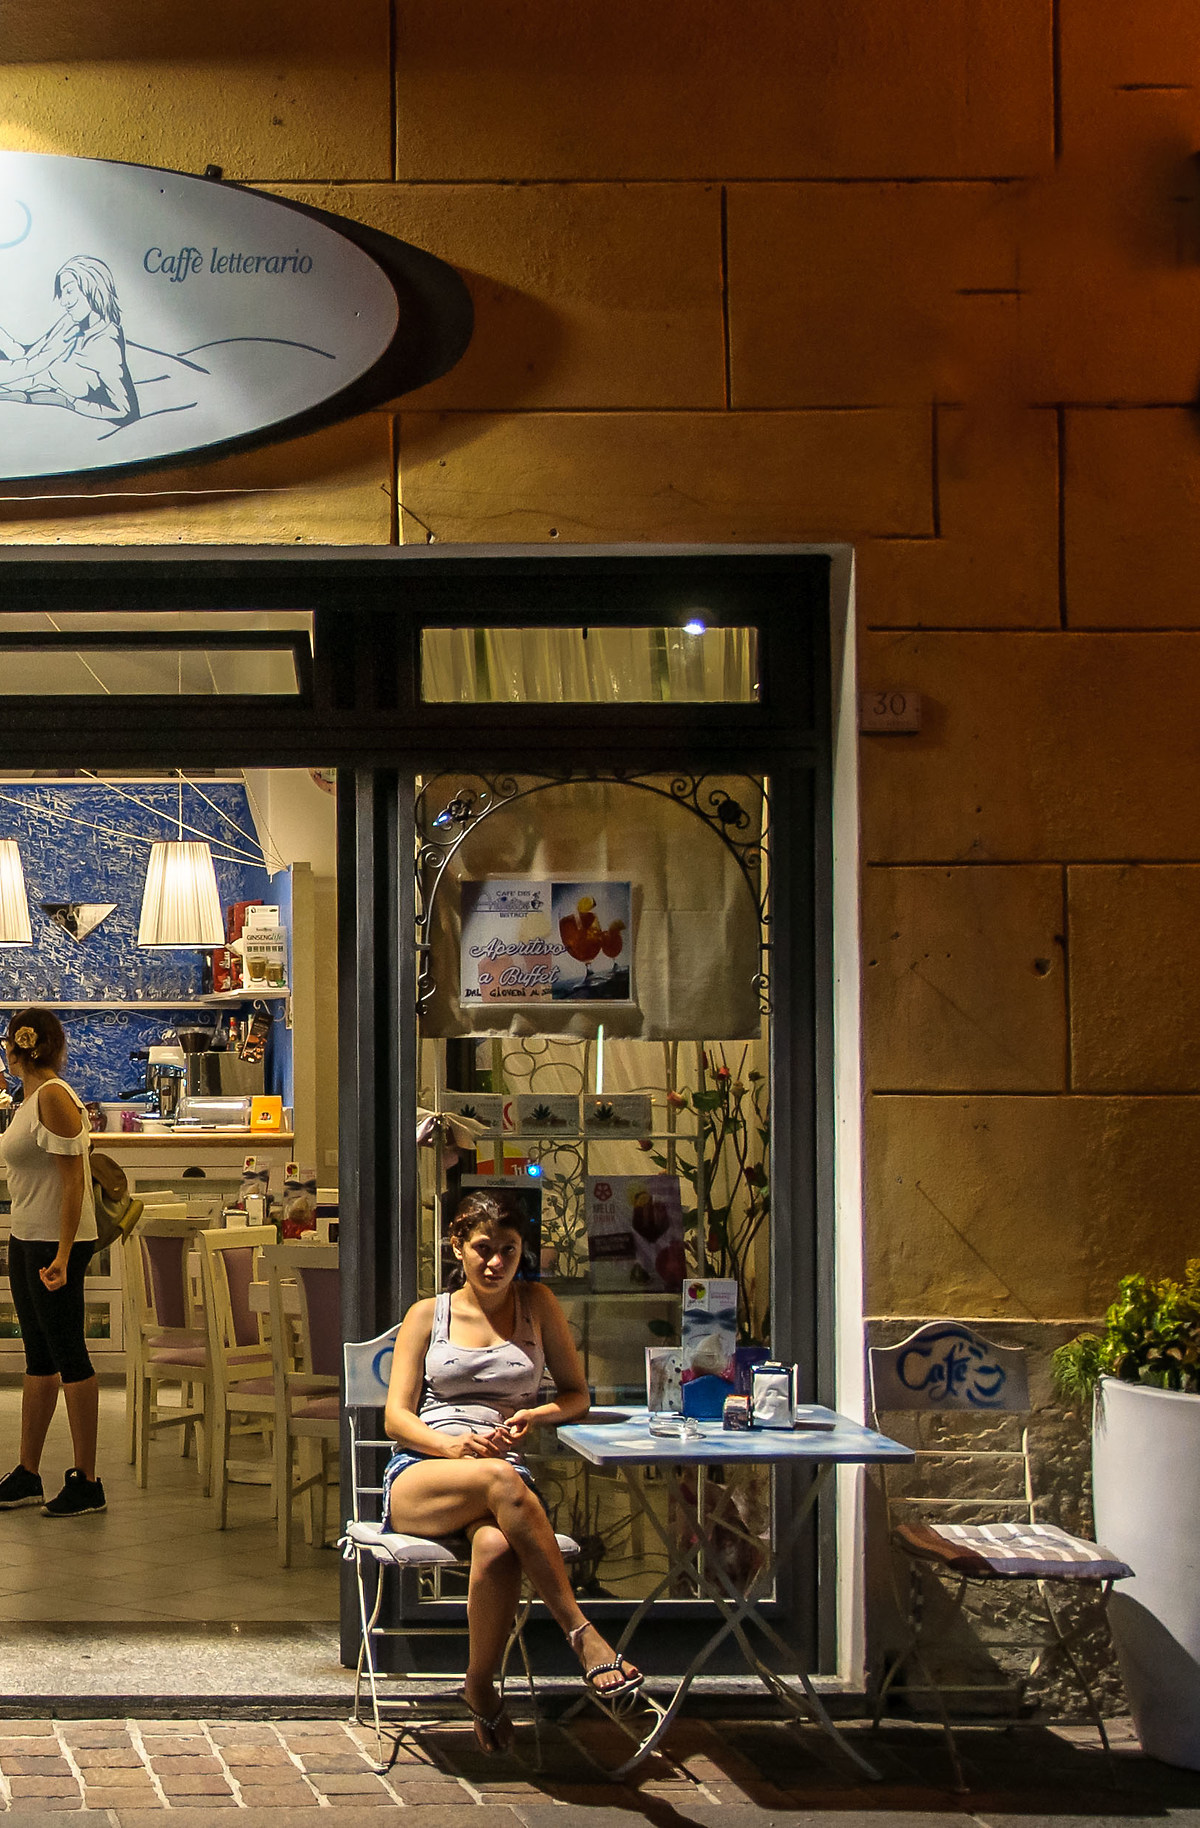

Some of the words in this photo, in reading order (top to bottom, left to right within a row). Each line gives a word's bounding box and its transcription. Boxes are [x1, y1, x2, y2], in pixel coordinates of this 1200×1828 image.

[143, 247, 203, 282] Caffè
[209, 247, 313, 275] letterario
[873, 692, 906, 716] 30
[470, 937, 568, 960] Aperitivo
[478, 970, 494, 984] a
[499, 964, 560, 987] Buffet
[896, 1341, 970, 1402] Café
